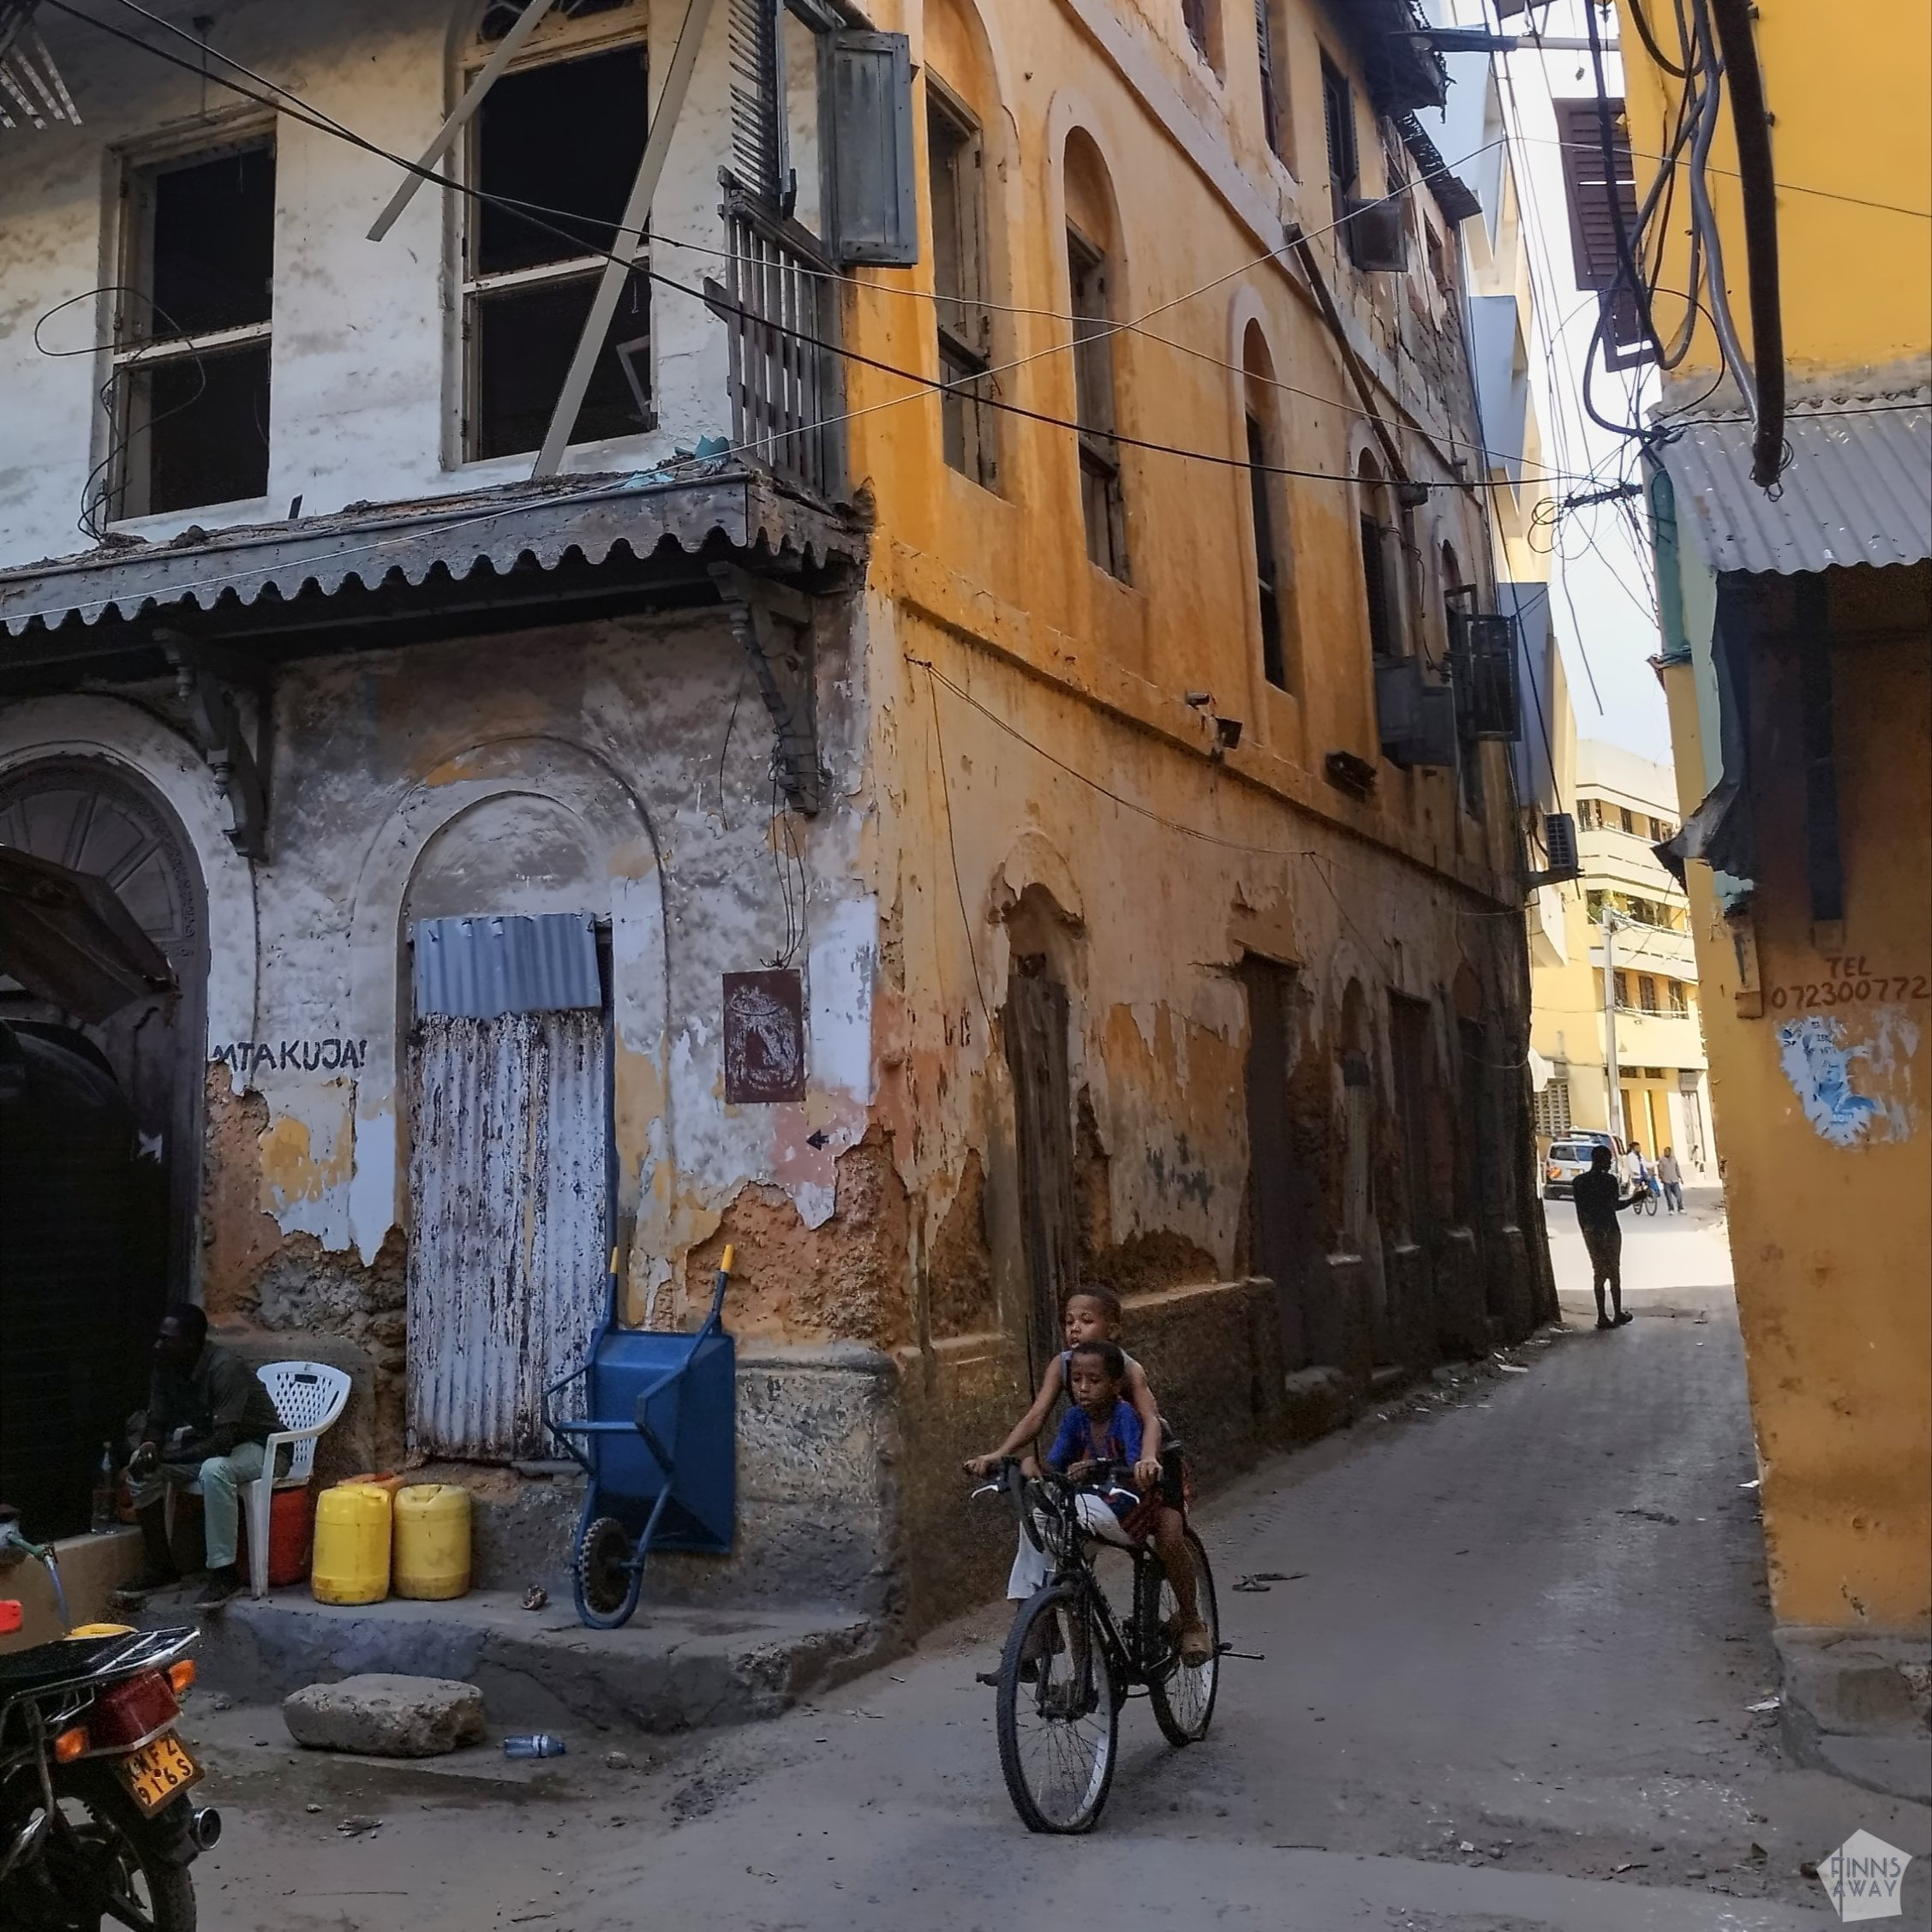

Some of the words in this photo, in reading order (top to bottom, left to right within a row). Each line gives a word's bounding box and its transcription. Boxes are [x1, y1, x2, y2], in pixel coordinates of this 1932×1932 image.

[1825, 955, 1872, 978] TEL
[1771, 975, 1931, 1009] 072300772
[212, 1038, 368, 1072] MTAKUJA!
[137, 1758, 191, 1804] 916S
